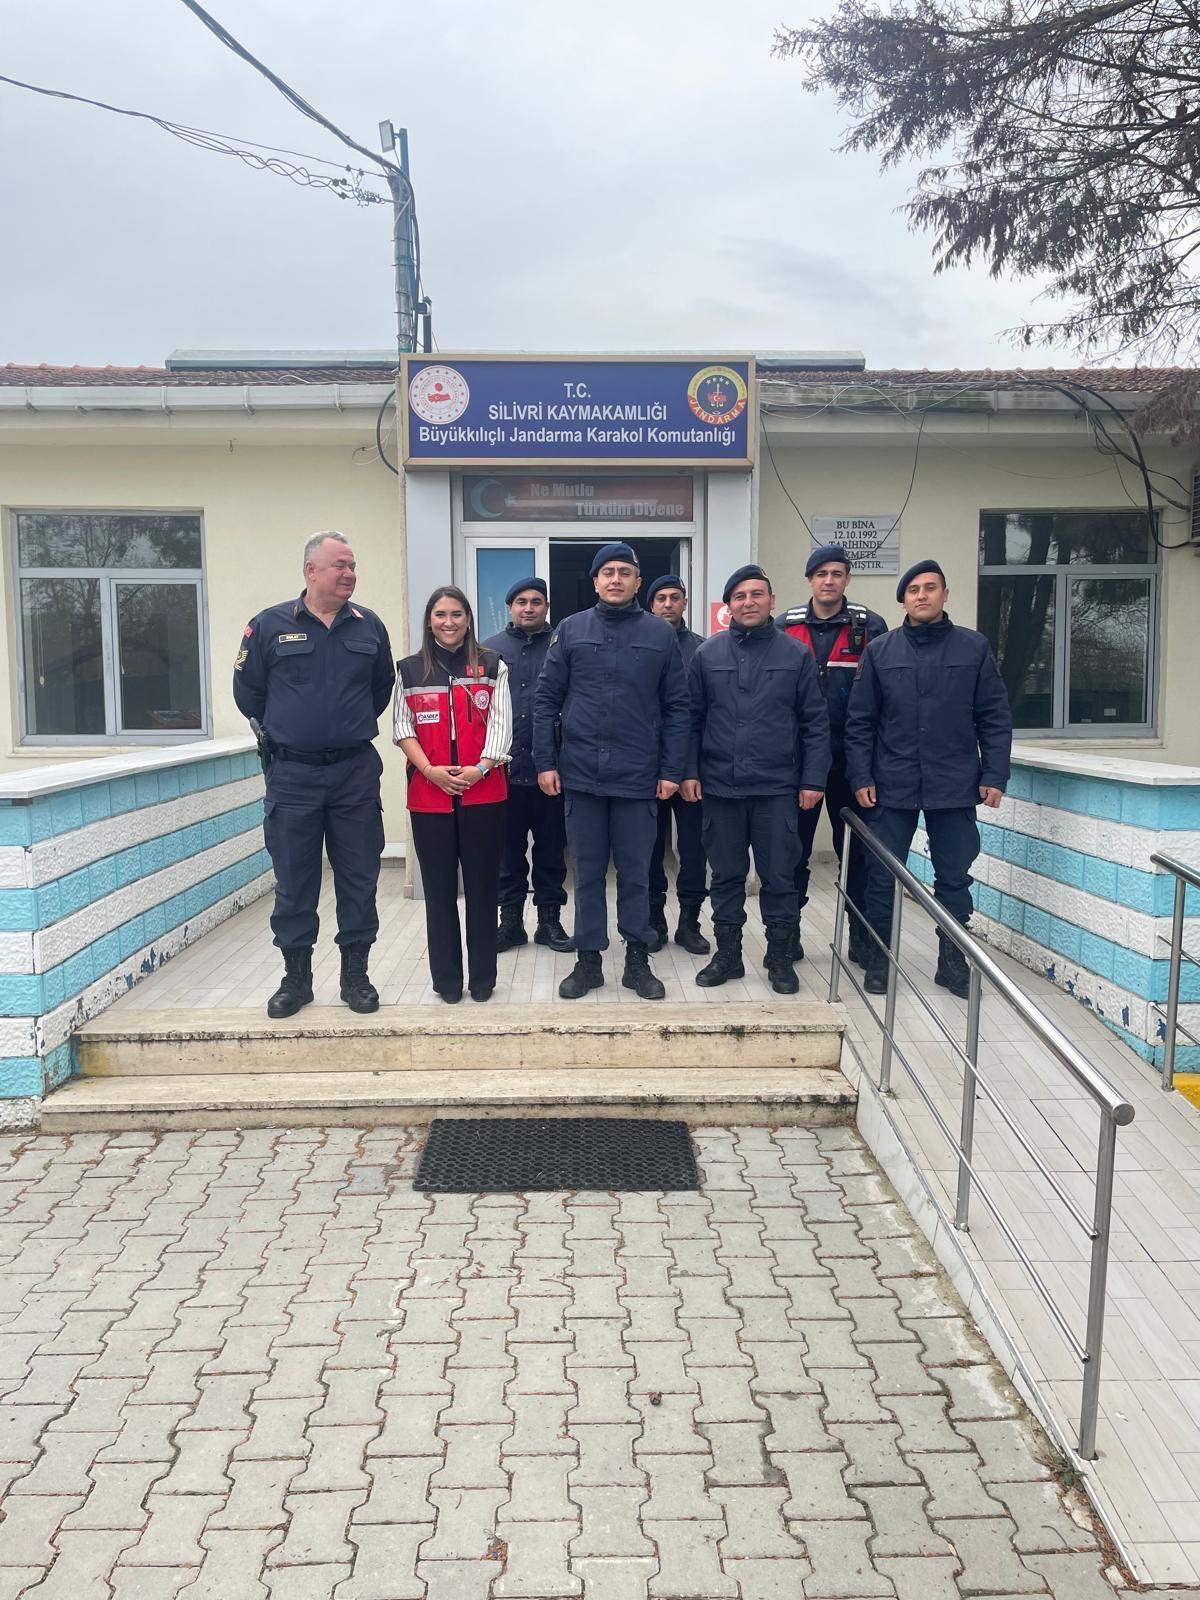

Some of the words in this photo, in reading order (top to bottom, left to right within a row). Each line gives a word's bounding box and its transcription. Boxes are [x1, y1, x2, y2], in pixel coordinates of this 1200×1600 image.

[563, 382, 592, 398] T.C.
[488, 401, 543, 420] SİLİVRİ
[548, 401, 667, 421] KAYMAKAMLIĞI
[689, 398, 746, 424] JANDARMA
[419, 426, 505, 446] Büyükkılıçlı
[509, 427, 583, 443] Jandarma
[587, 427, 643, 443] Karakol
[647, 427, 736, 446] Komutanlığı
[530, 483, 550, 497] Ne
[552, 482, 594, 497] Mutlu
[576, 501, 632, 516] Türküm
[634, 502, 685, 517] Diyene
[836, 520, 850, 529] BU
[852, 519, 875, 529] BİNA
[833, 530, 878, 539] 12.10.1992
